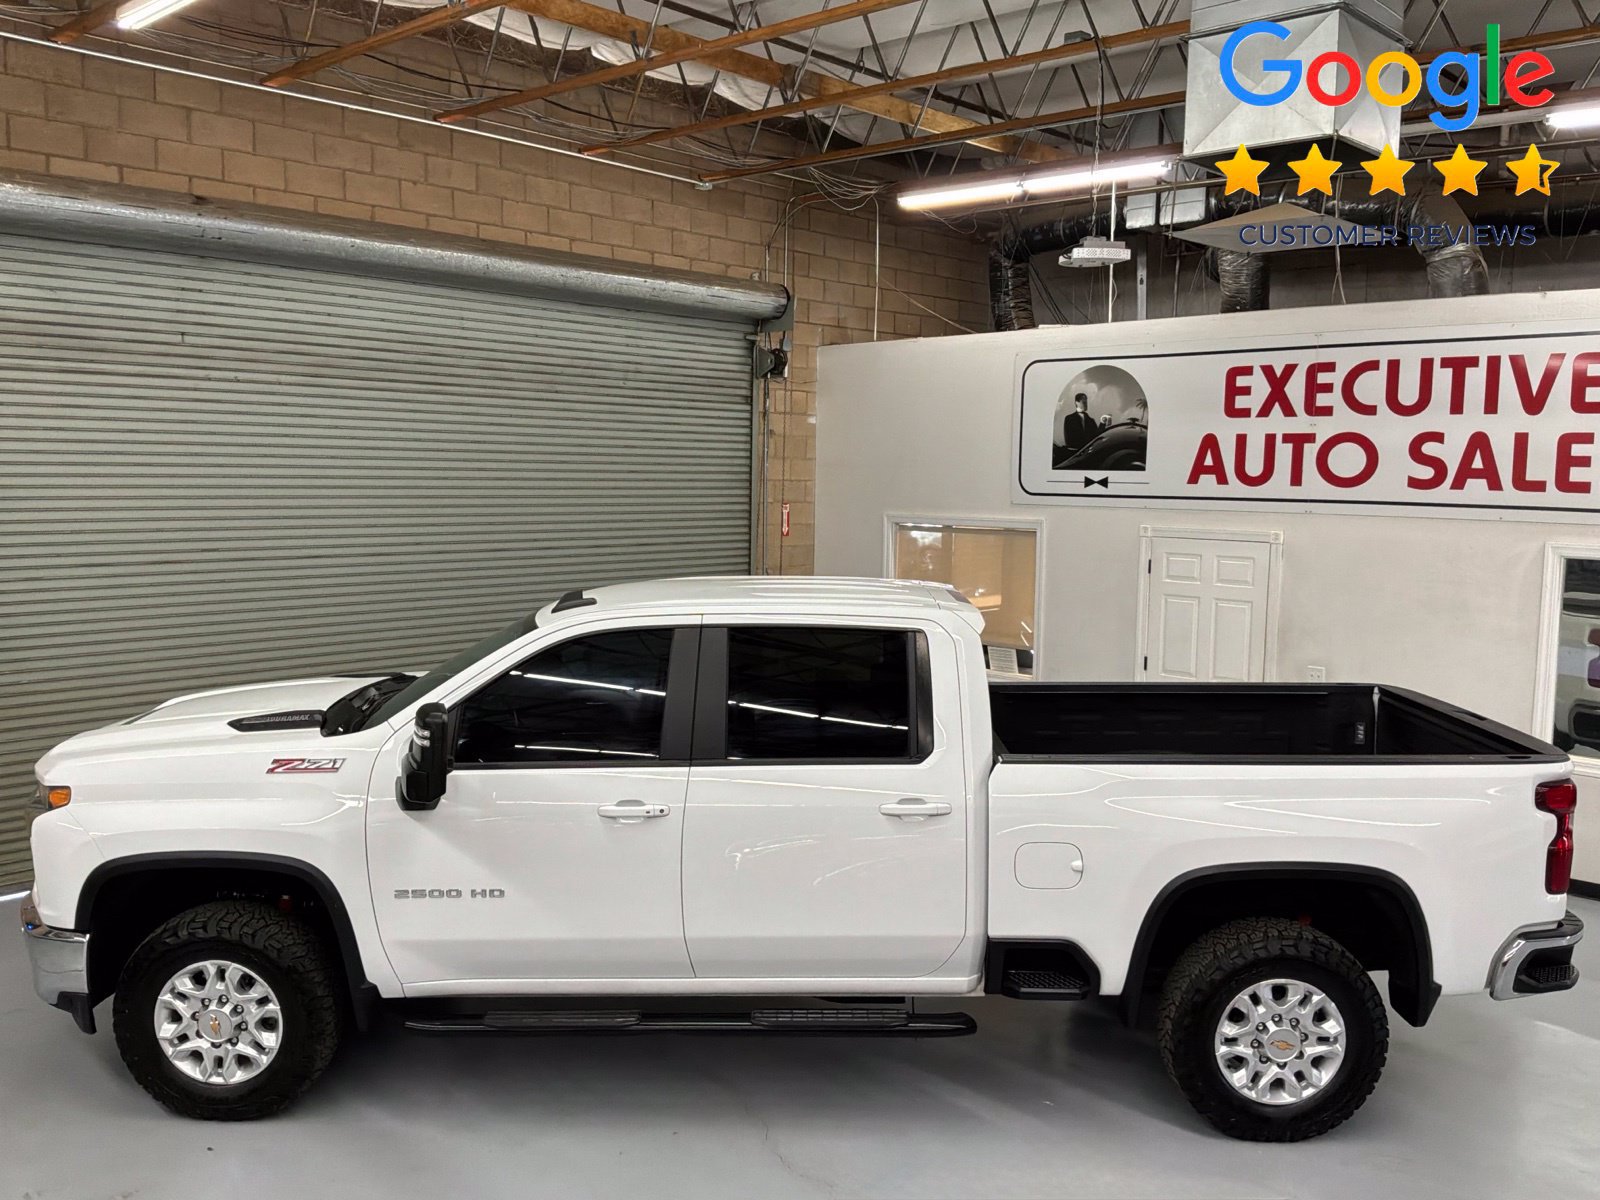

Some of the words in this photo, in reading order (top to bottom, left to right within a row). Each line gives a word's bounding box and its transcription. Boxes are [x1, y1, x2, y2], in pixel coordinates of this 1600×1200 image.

[1225, 352, 1600, 418] EXECUTIVE
[1187, 431, 1379, 488] AUTO
[1406, 431, 1595, 494] SALE
[265, 758, 347, 774] Z71
[394, 889, 462, 899] 2500
[471, 889, 505, 899] HD
